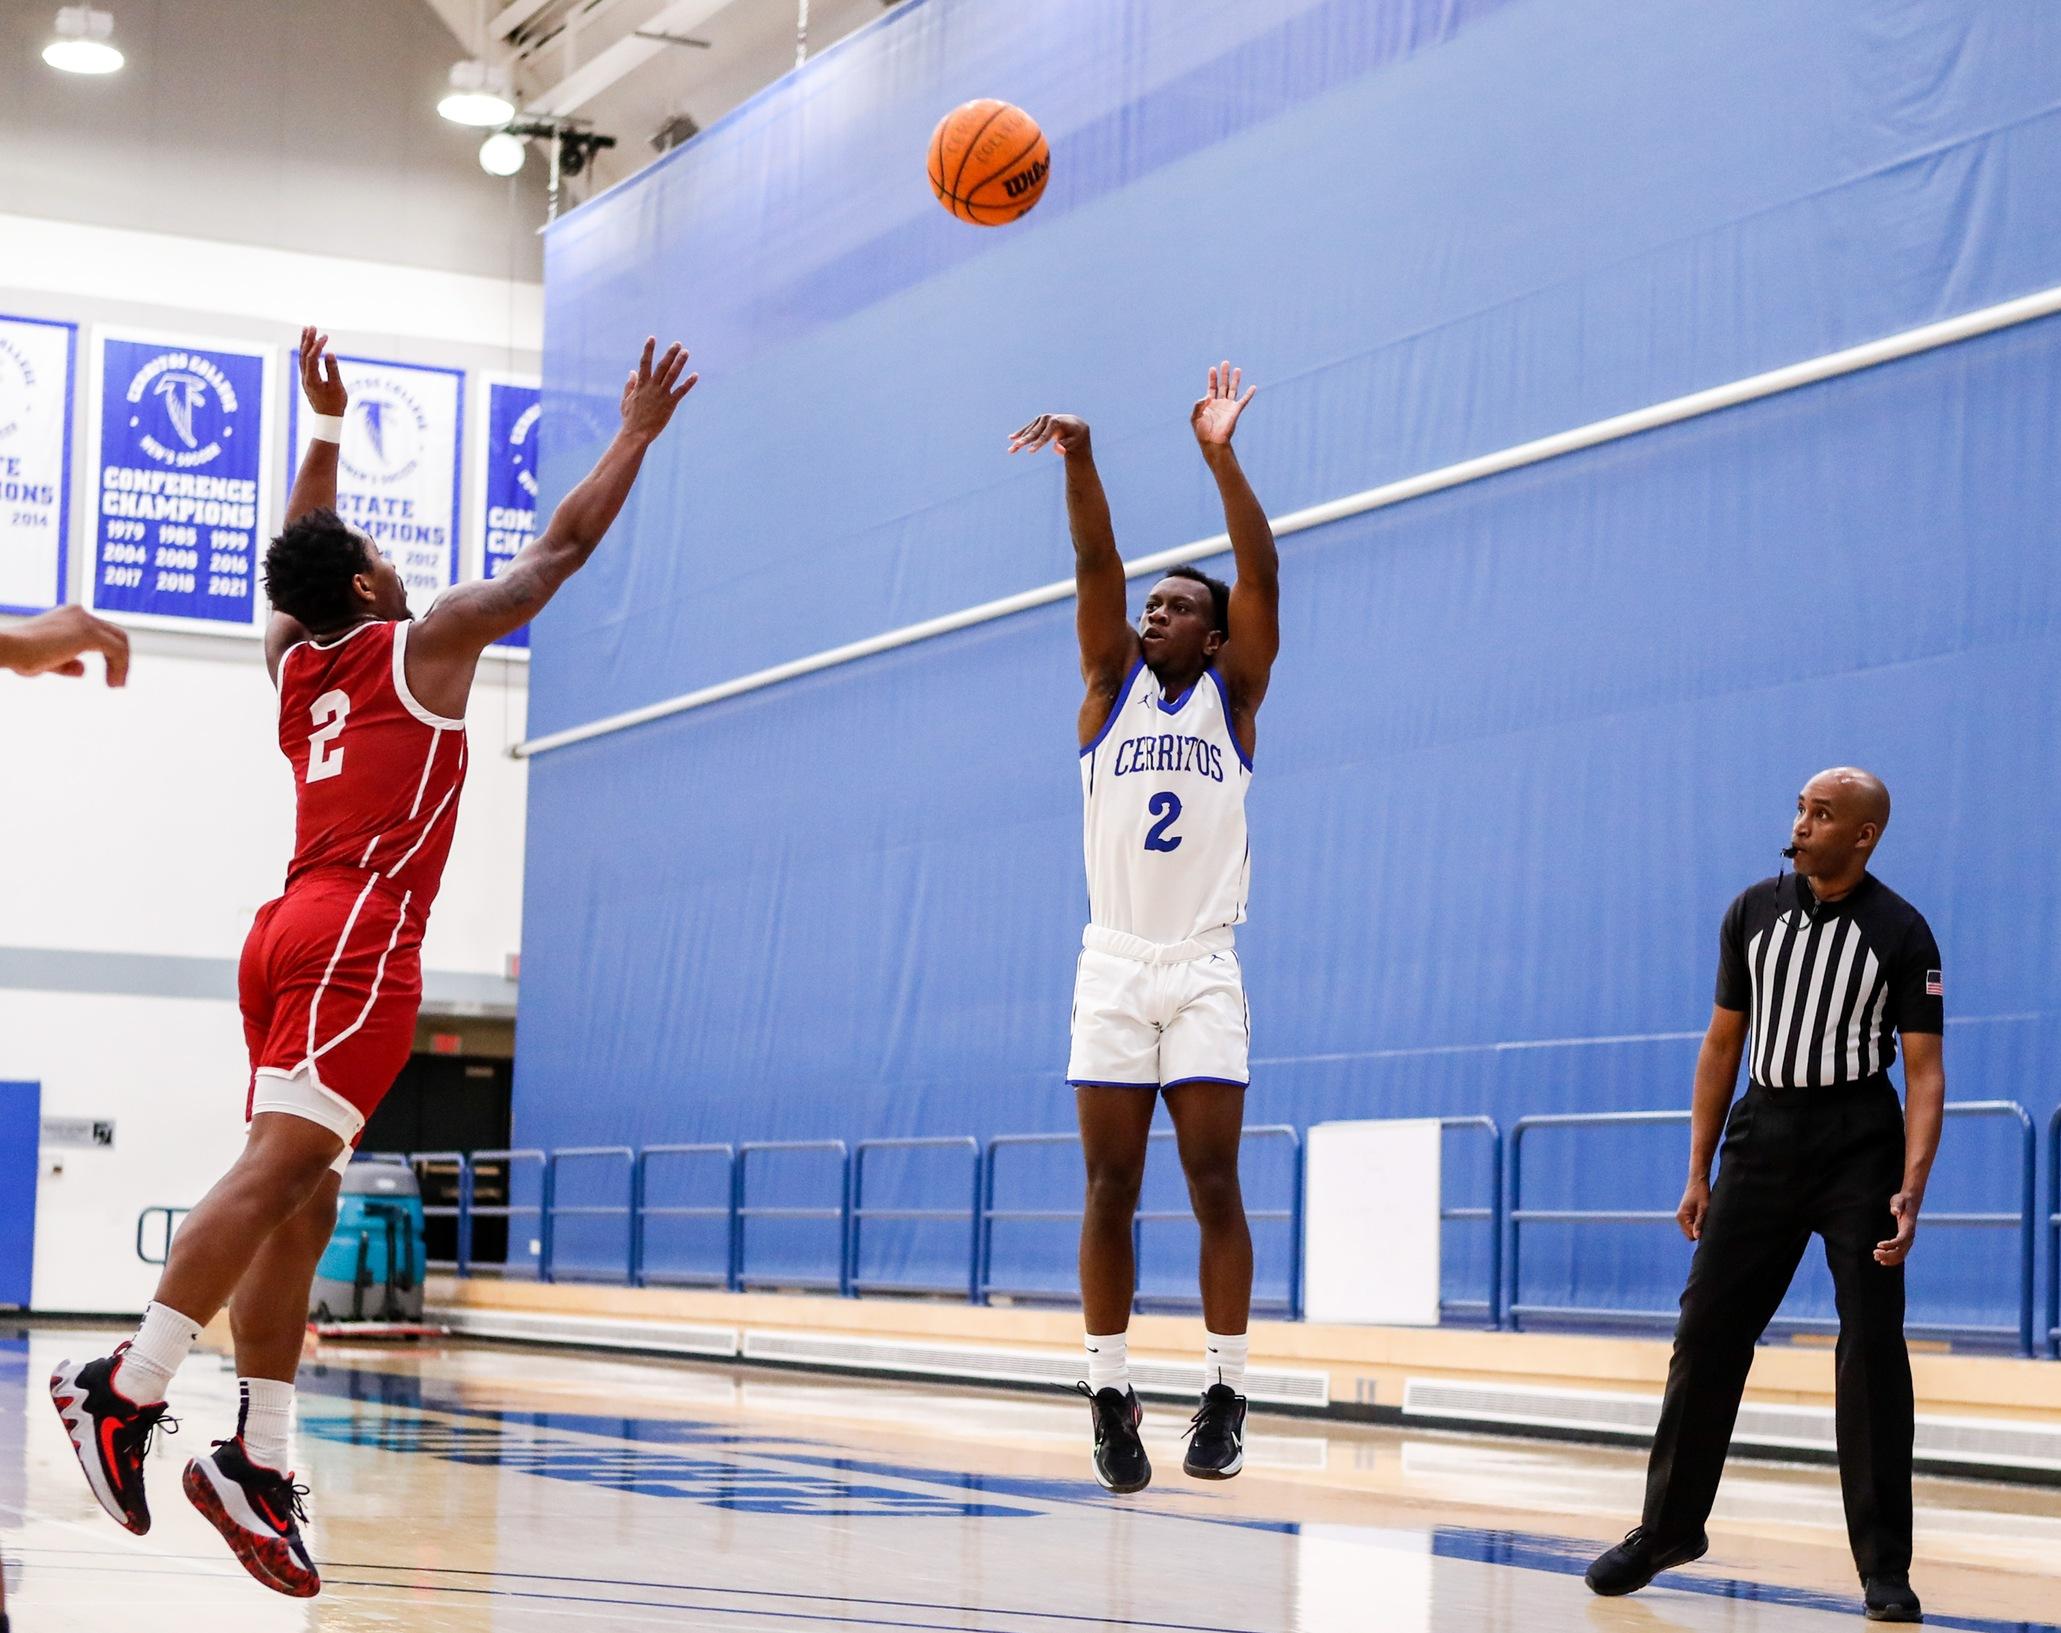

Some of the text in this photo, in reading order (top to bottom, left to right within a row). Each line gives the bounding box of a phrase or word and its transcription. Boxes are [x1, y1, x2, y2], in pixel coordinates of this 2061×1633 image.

[103, 466, 256, 503] CONFERENCE
[337, 494, 414, 518] STATE
[102, 490, 255, 528] CHAMPIONS
[306, 688, 350, 784] 2
[1114, 734, 1224, 783] CERRITOS
[1144, 791, 1183, 853] 2
